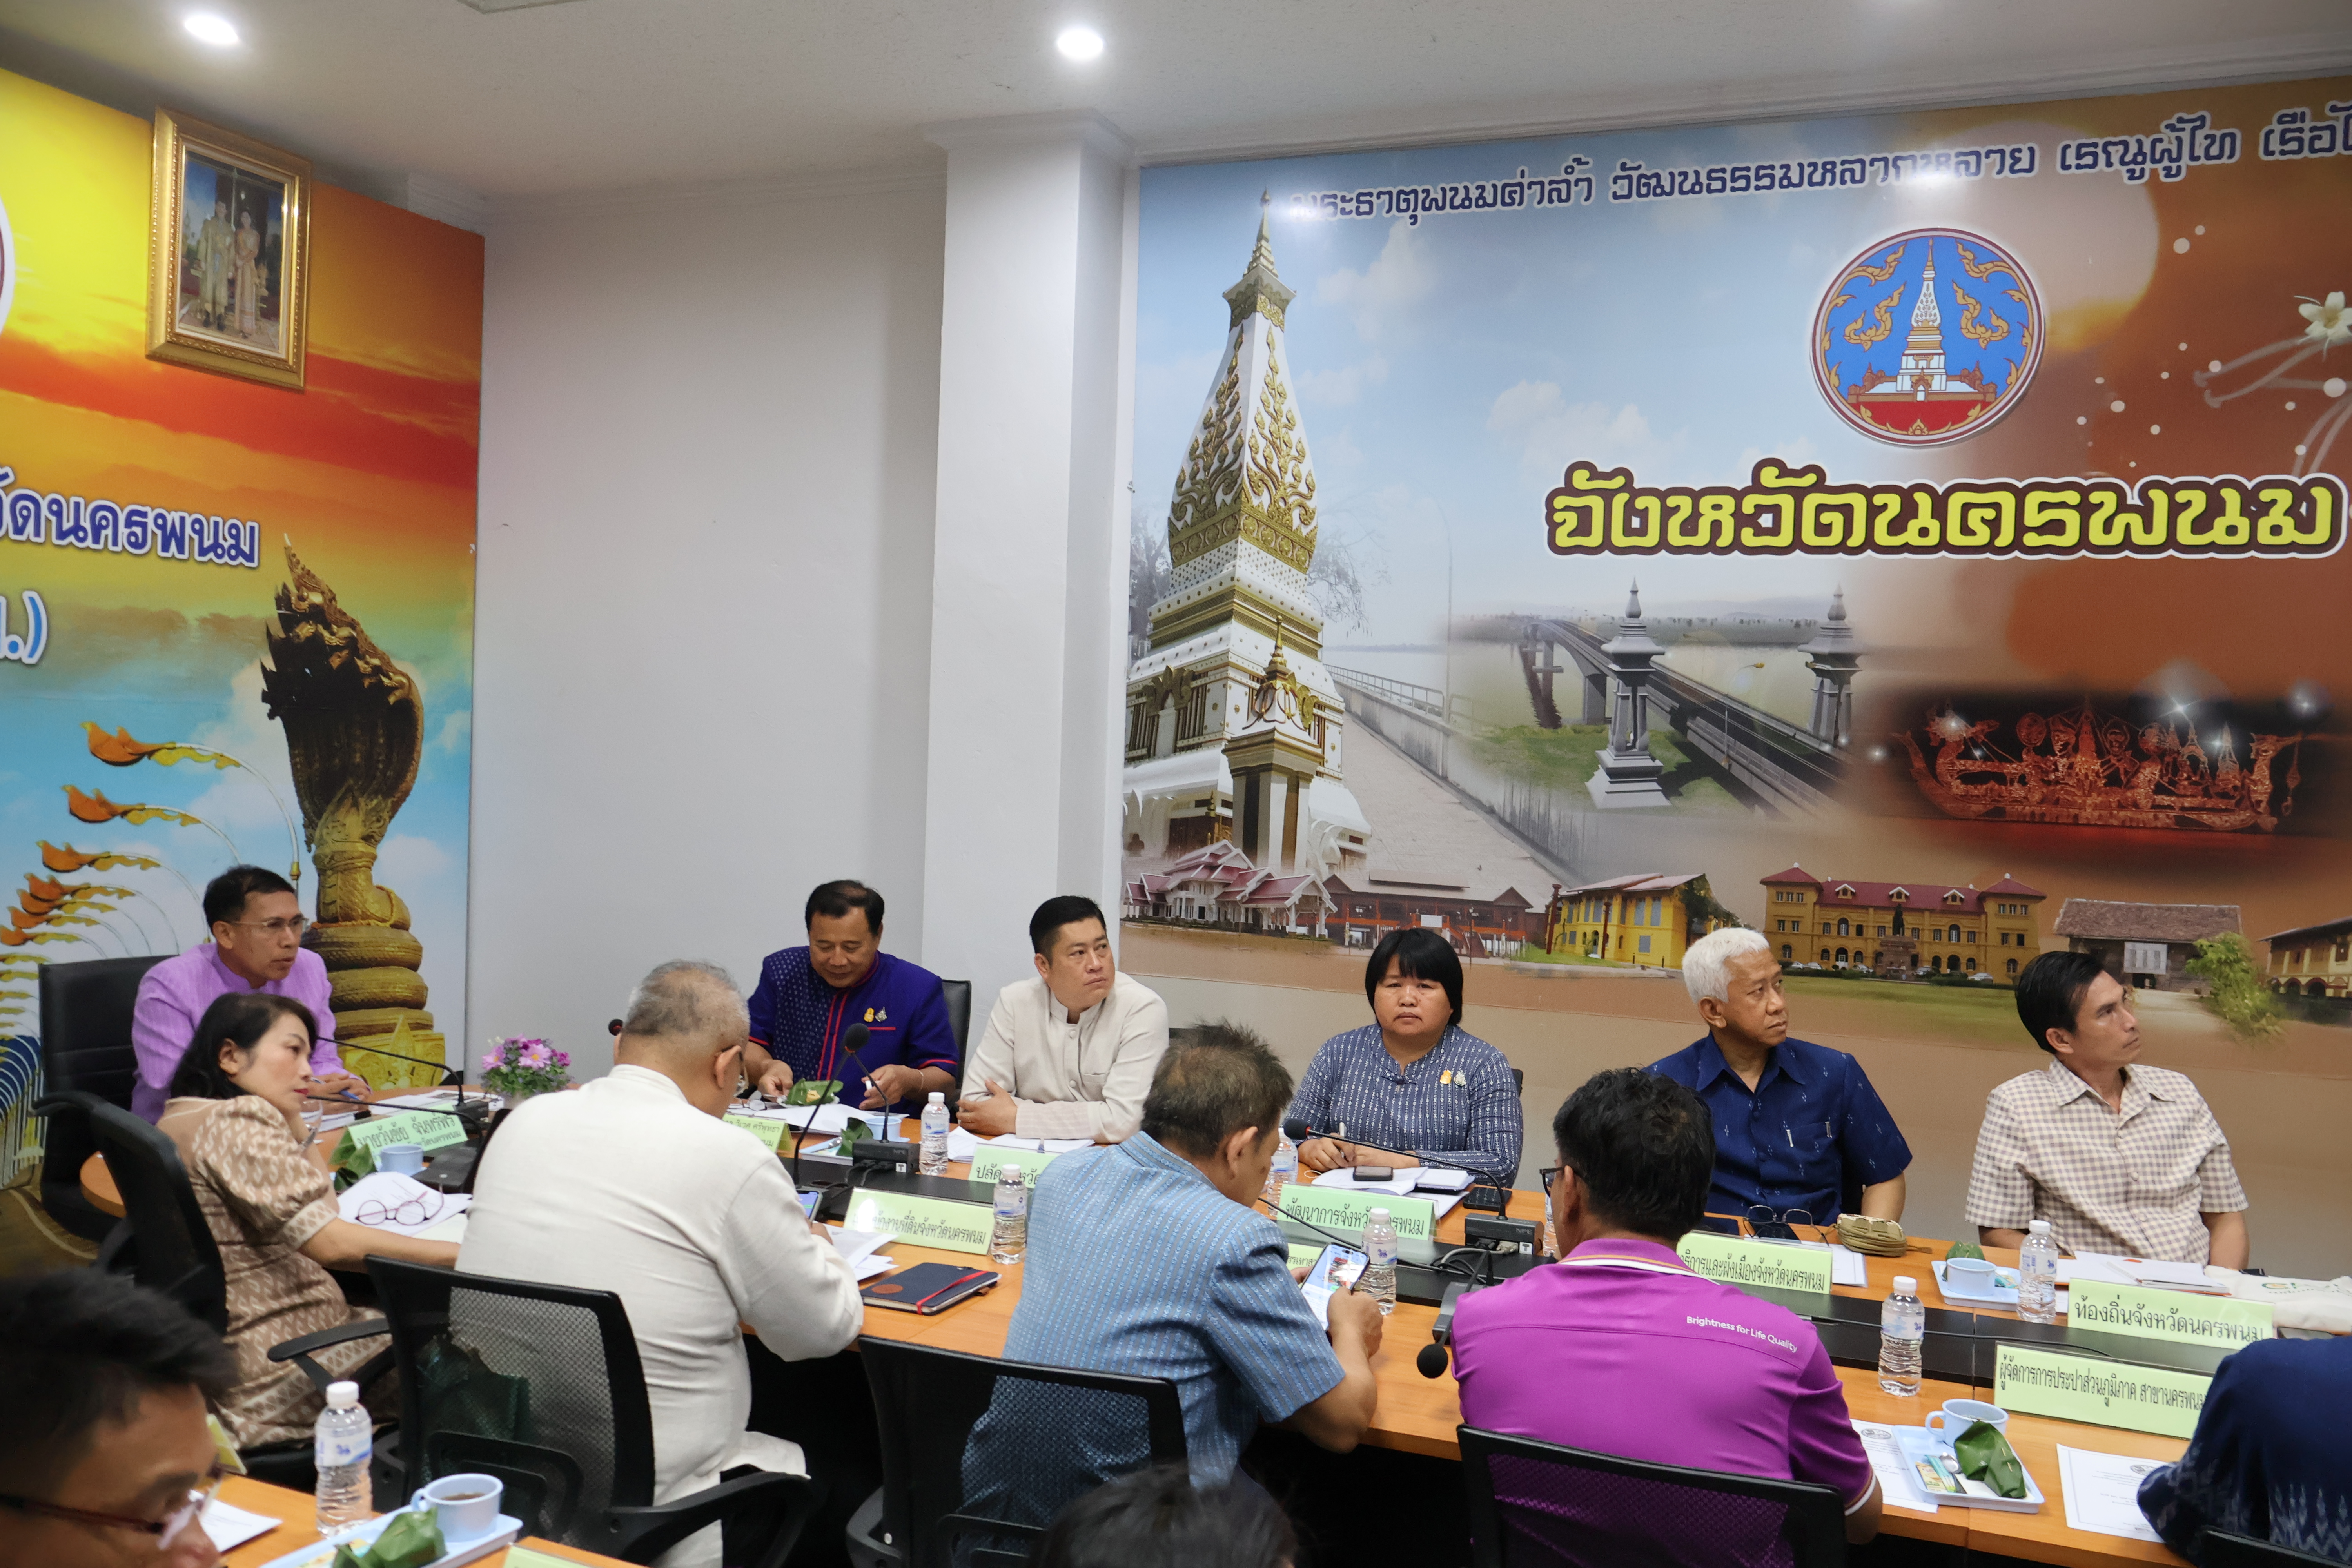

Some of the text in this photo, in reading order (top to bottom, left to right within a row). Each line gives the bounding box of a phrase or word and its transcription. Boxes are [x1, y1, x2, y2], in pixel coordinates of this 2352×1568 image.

[2061, 115, 2236, 180] เรณูผู้ไท
[0, 472, 256, 564] ัดนครพนม
[1553, 466, 2333, 548] จังหวัดนครพนม
[1285, 1197, 1424, 1236] พัฒนาการจังหวัรพนม
[1686, 1316, 1798, 1353] Brightness for Life Quality
[2074, 1294, 2263, 1342] ท้องถิ่นจังหวัดนครพนม
